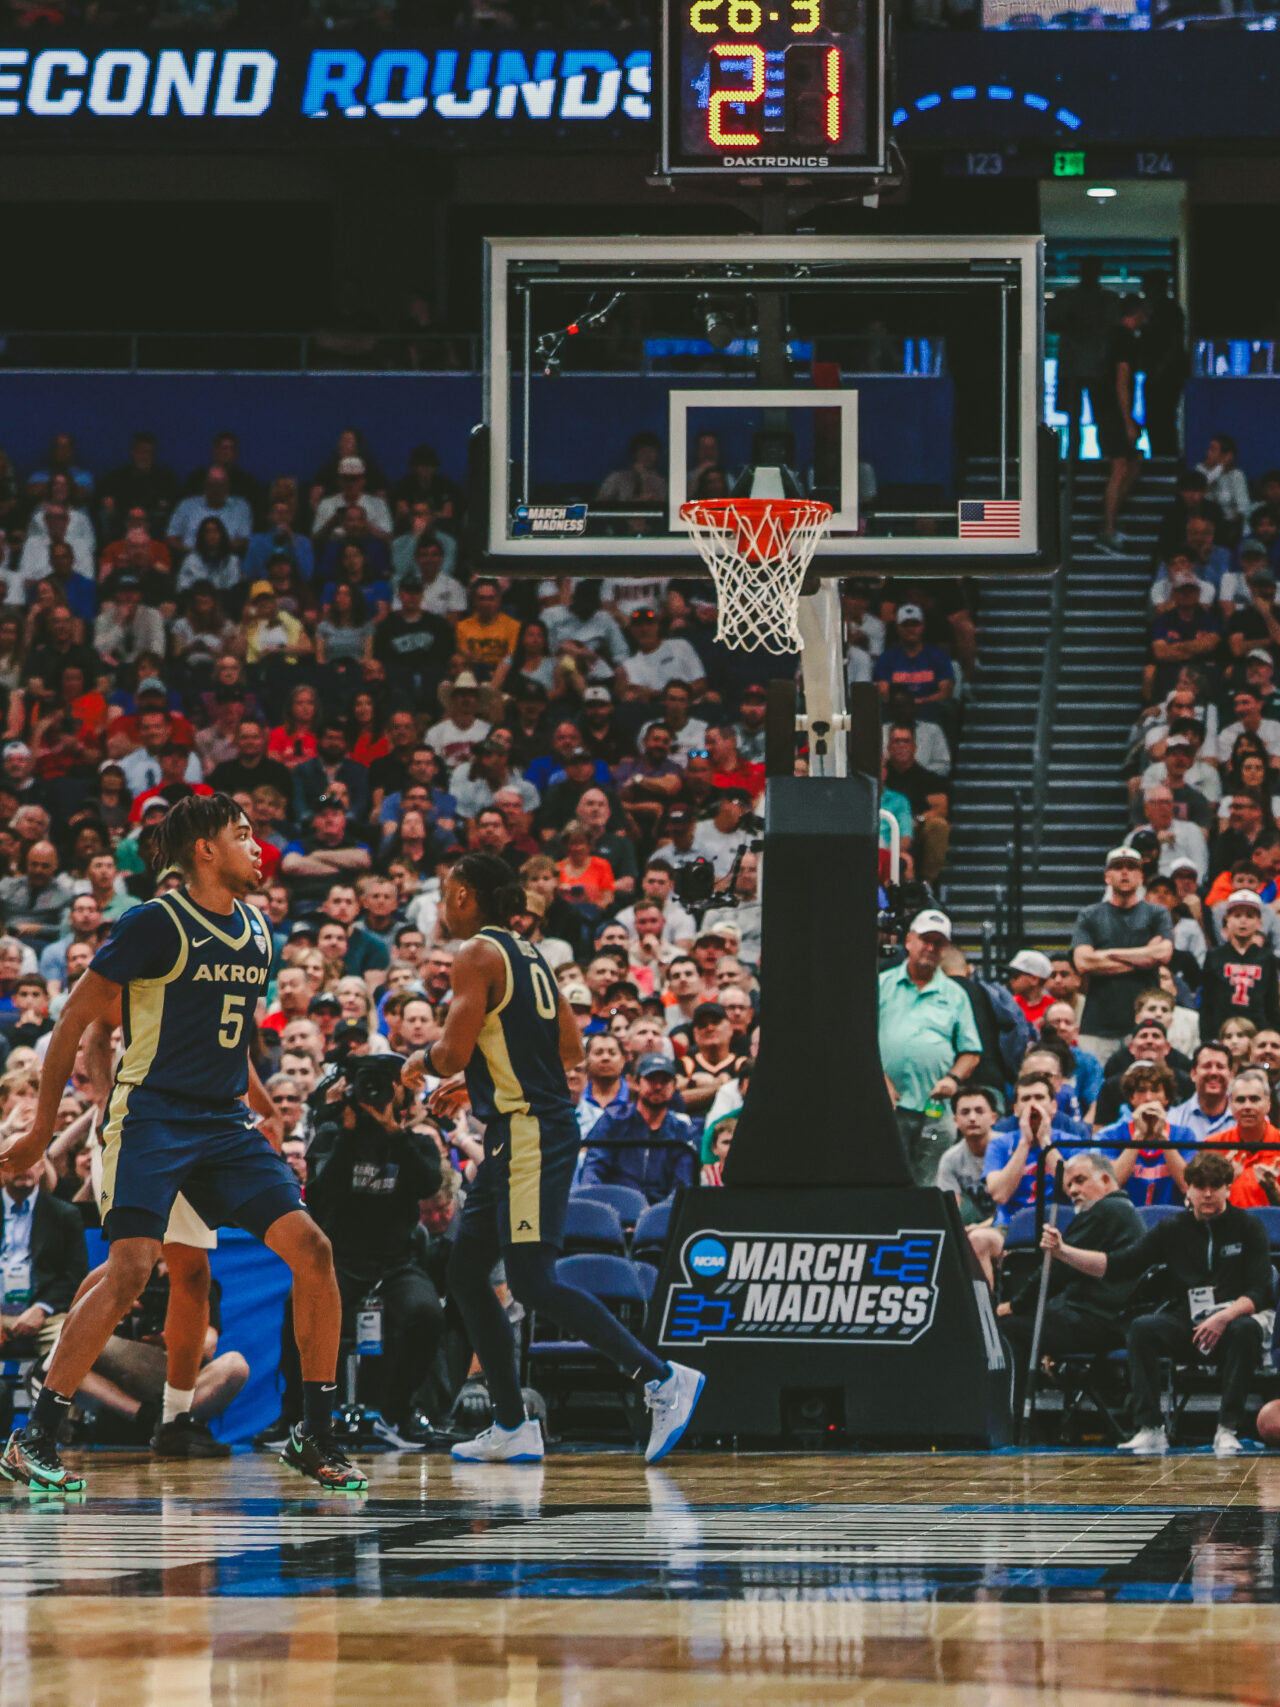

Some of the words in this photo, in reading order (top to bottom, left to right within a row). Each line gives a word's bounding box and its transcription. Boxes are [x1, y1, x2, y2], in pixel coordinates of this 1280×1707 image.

[708, 44, 840, 146] 21
[723, 156, 829, 167] DAKTRONICS
[967, 152, 1002, 175] 123
[1137, 152, 1173, 174] 124
[528, 508, 567, 519] MARCH
[532, 520, 584, 531] MADNESS
[192, 964, 268, 985] AKRON
[529, 962, 557, 1020] 0
[218, 993, 247, 1049] 5
[517, 1220, 533, 1231] A
[692, 1256, 726, 1267] NCAA
[727, 1241, 868, 1281] MARCH
[742, 1283, 931, 1325] MADNESS
